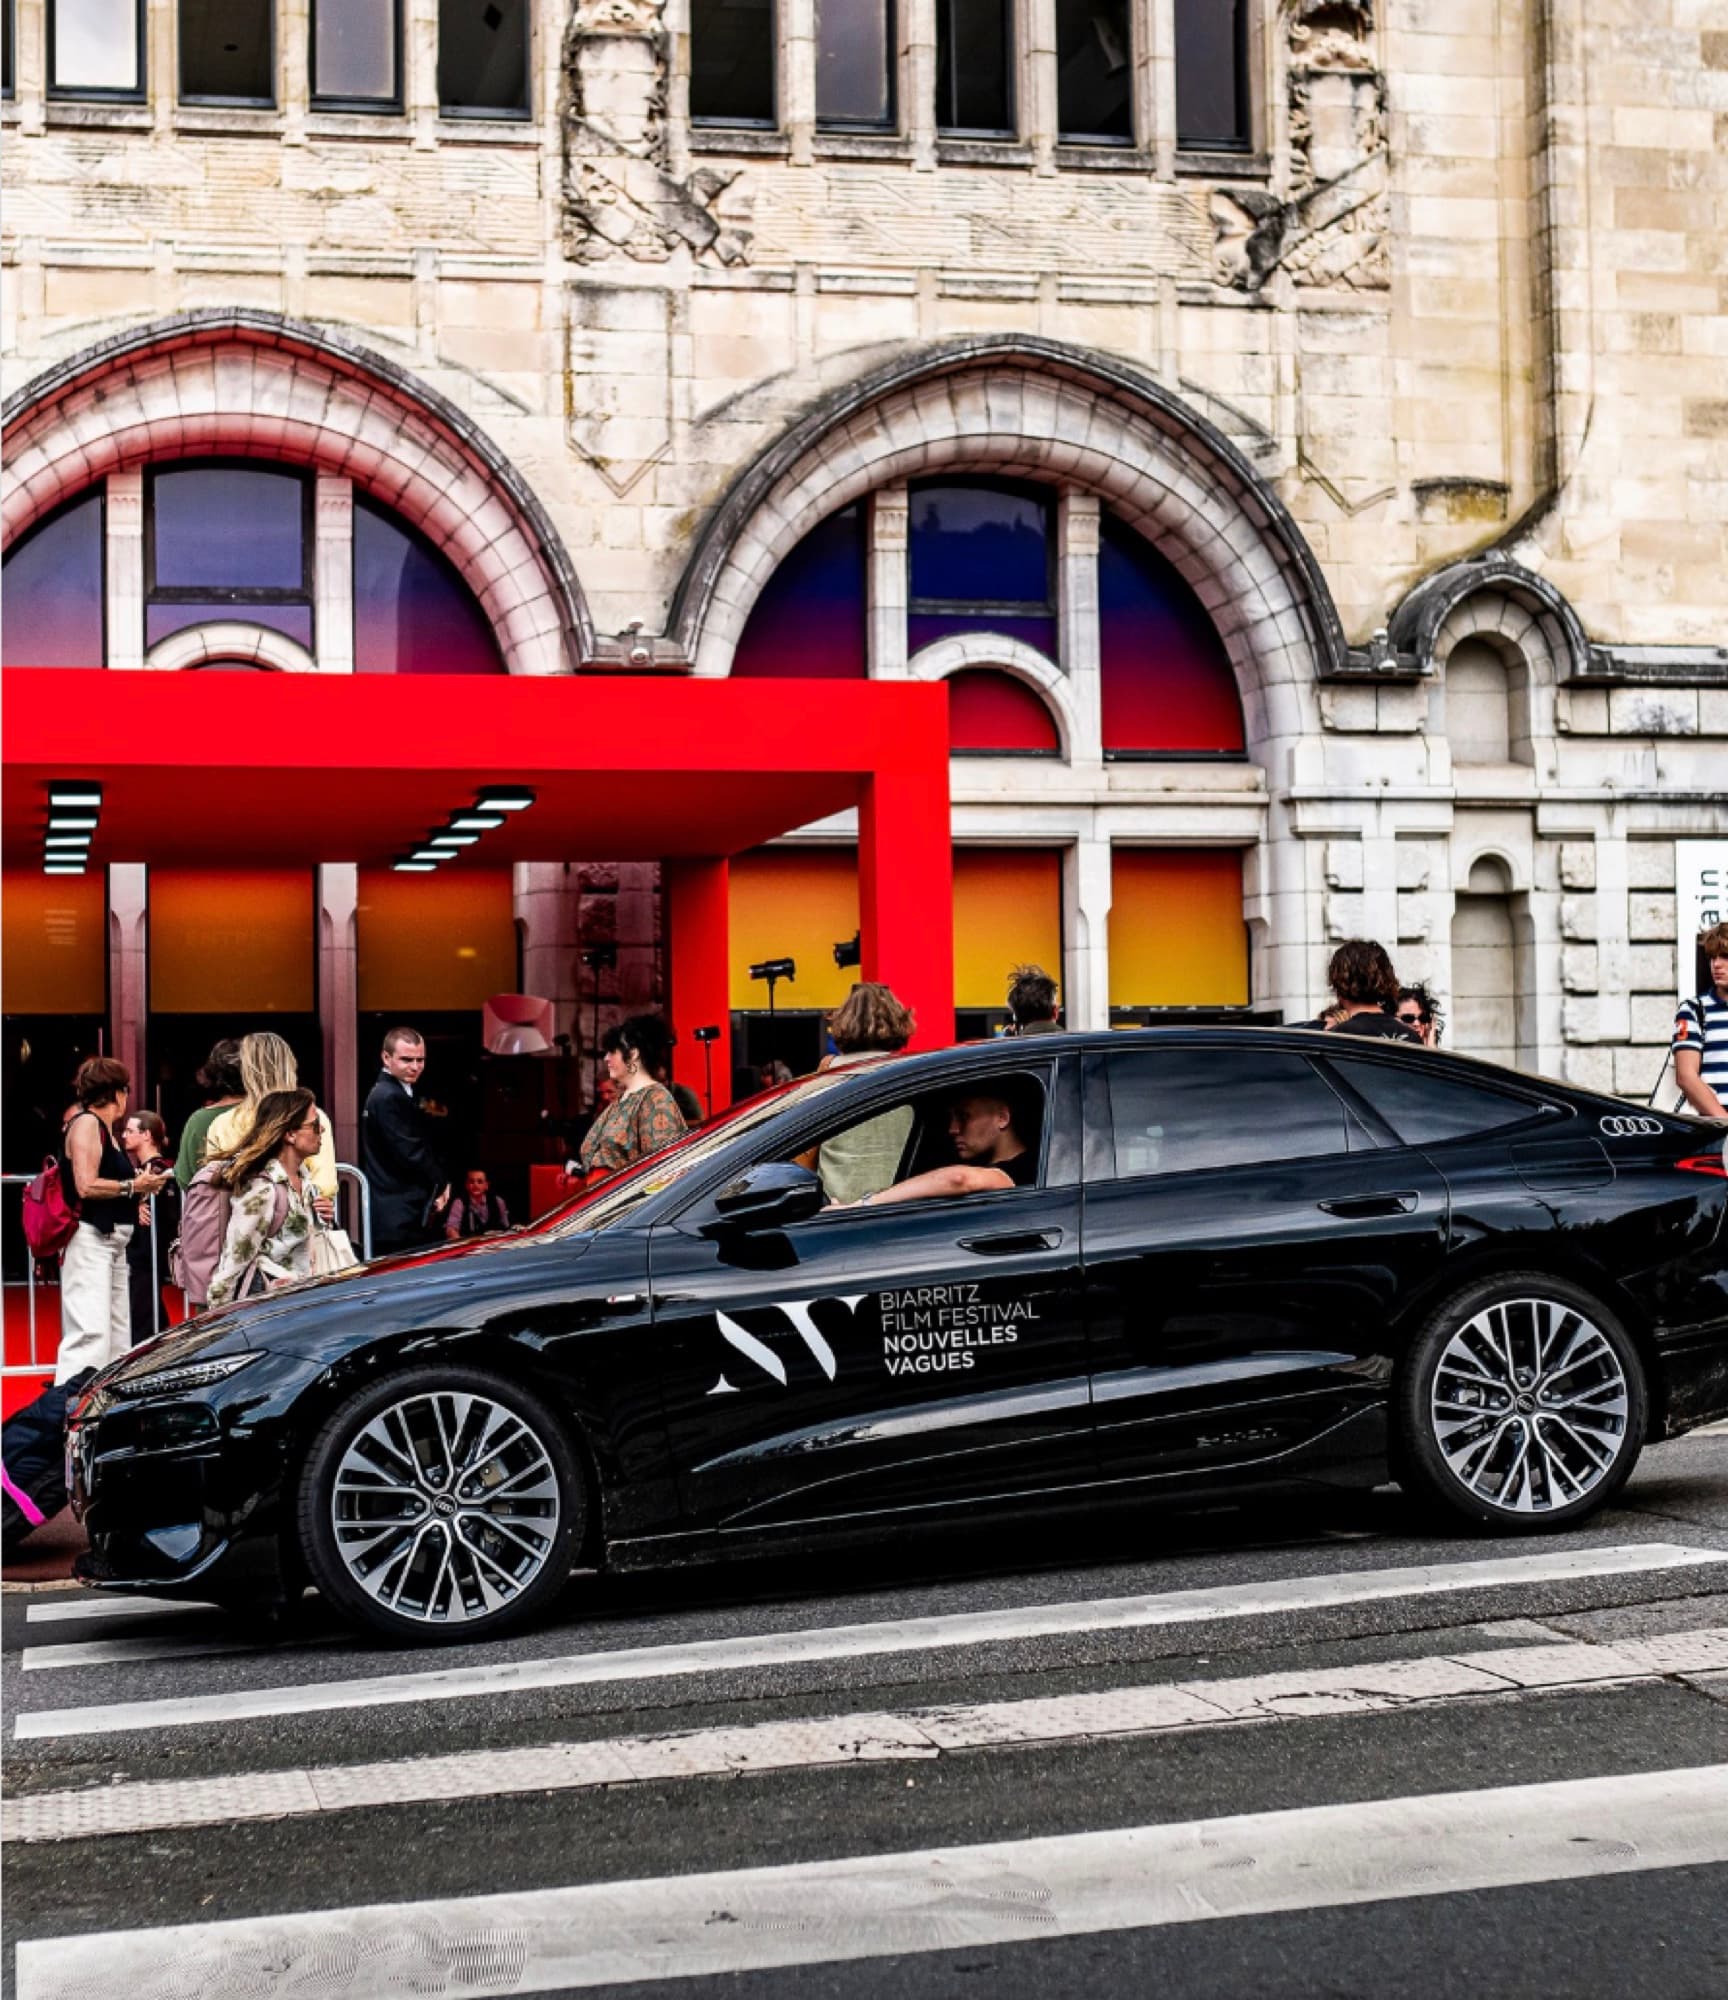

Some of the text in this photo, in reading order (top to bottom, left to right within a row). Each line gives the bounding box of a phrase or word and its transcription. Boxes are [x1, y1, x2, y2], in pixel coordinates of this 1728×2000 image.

[1696, 869, 1719, 927] ain
[880, 1284, 981, 1311] BIARRITZ
[881, 1301, 1041, 1332] FILM FESTIVAL
[884, 1325, 1018, 1353] NOUVELLES
[884, 1352, 975, 1376] VAGUES
